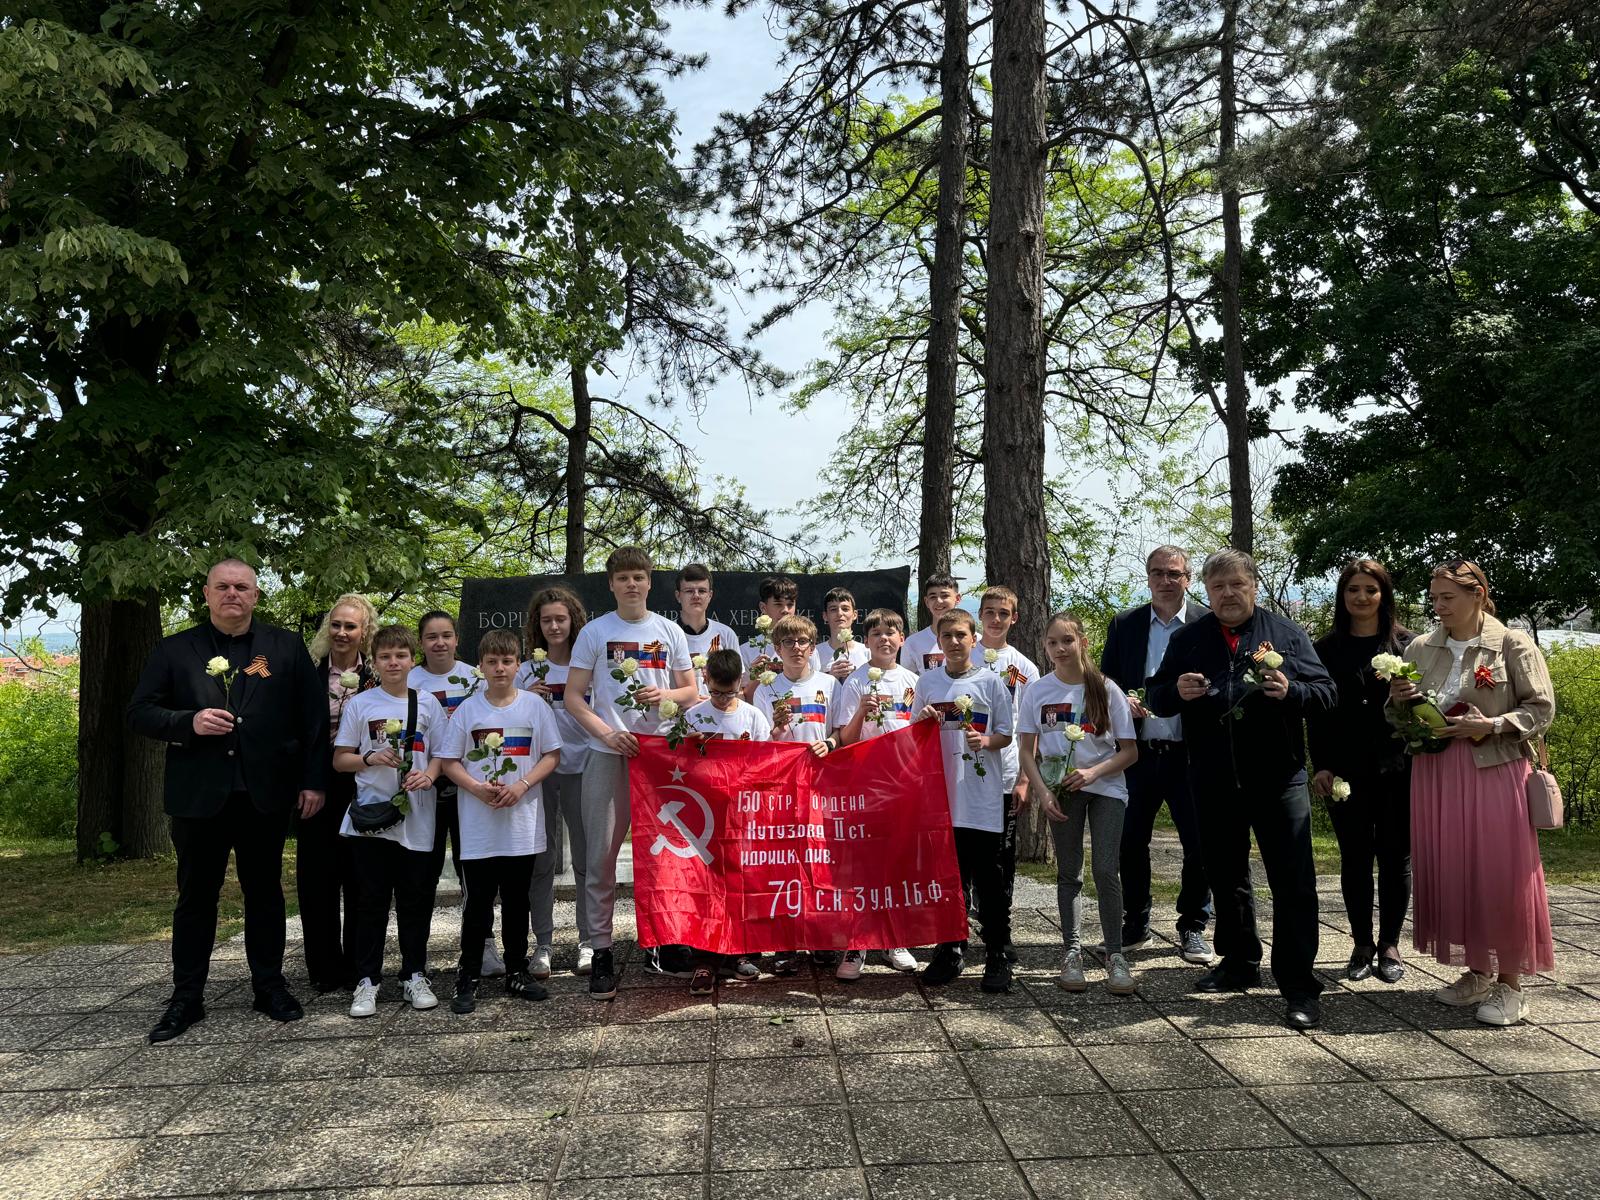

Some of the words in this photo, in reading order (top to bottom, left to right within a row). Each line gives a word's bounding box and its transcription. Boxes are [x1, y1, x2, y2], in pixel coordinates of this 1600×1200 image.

[737, 790, 761, 812] 150
[768, 794, 799, 811] СТР.
[812, 793, 865, 812] ОРДЕНА
[740, 848, 800, 866] ИДРИЦК.
[804, 847, 836, 865] ДИВ.
[768, 878, 802, 919] 79
